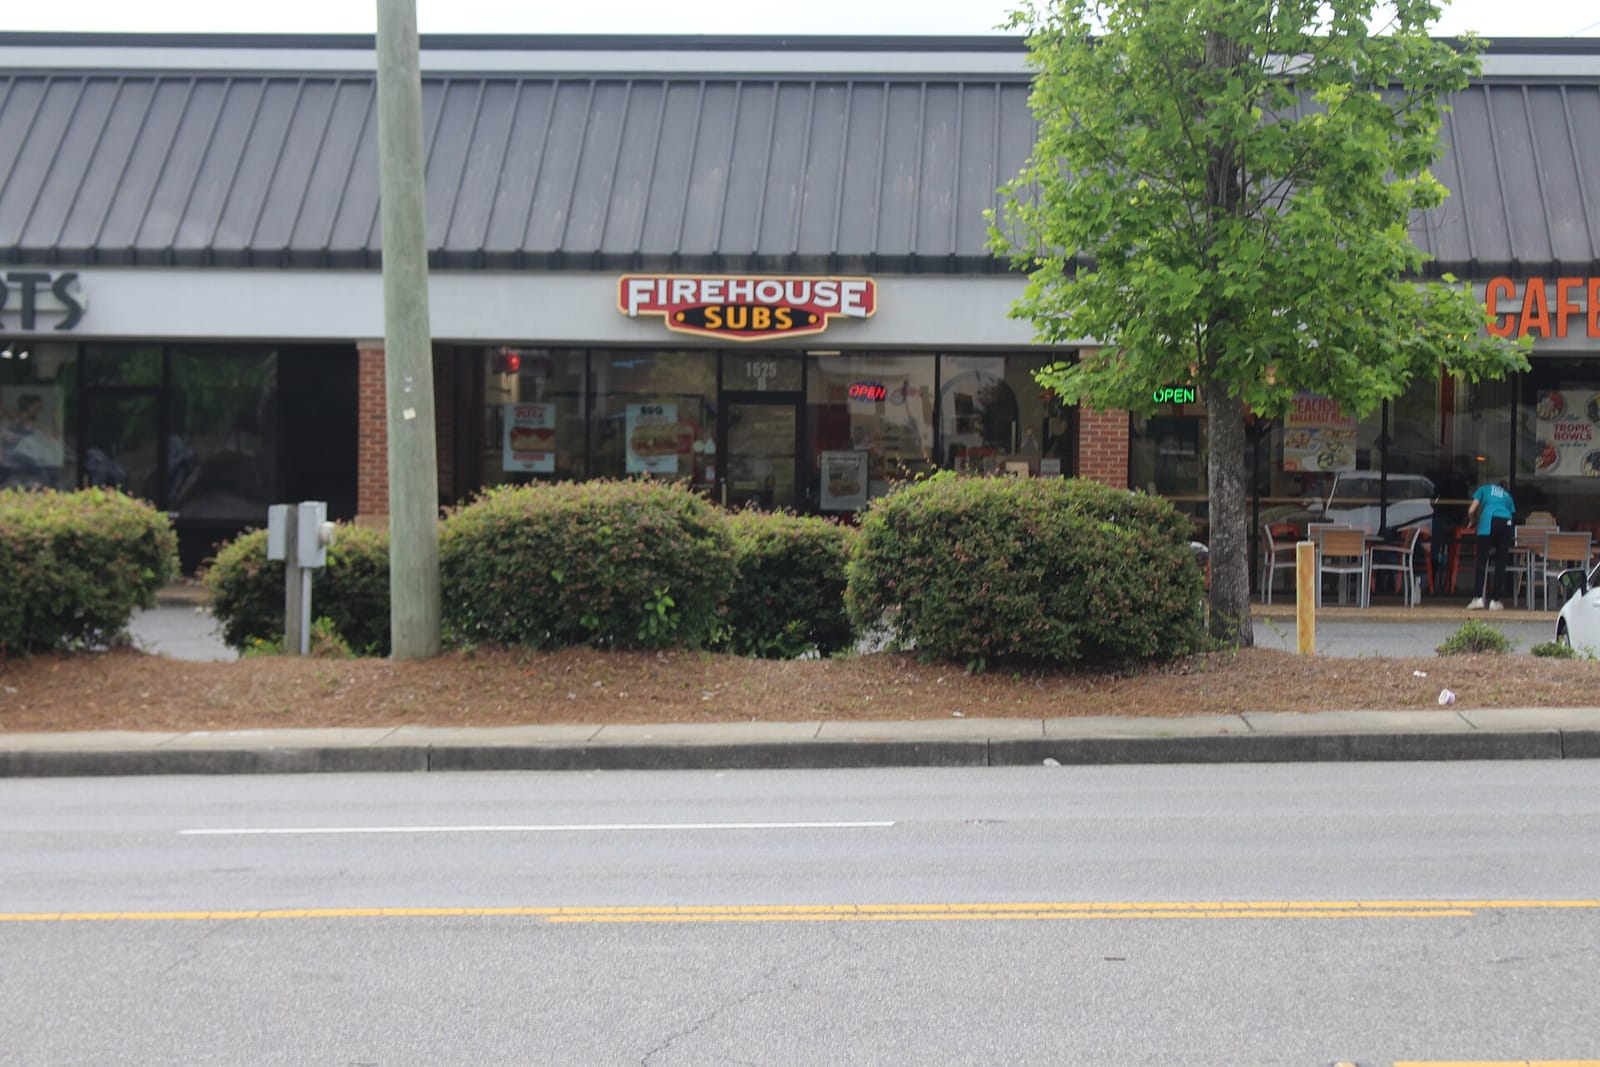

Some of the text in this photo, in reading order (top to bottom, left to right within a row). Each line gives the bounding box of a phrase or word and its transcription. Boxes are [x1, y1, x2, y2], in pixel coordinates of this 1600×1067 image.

[0, 272, 84, 330] TS
[628, 279, 867, 317] FIREHOUSE
[704, 306, 793, 330] SUBS
[746, 361, 777, 378] 1525
[848, 384, 886, 400] OPEN
[1153, 387, 1195, 404] OPEN
[1553, 423, 1592, 432] TROPIC
[1553, 432, 1593, 441] BOWLS
